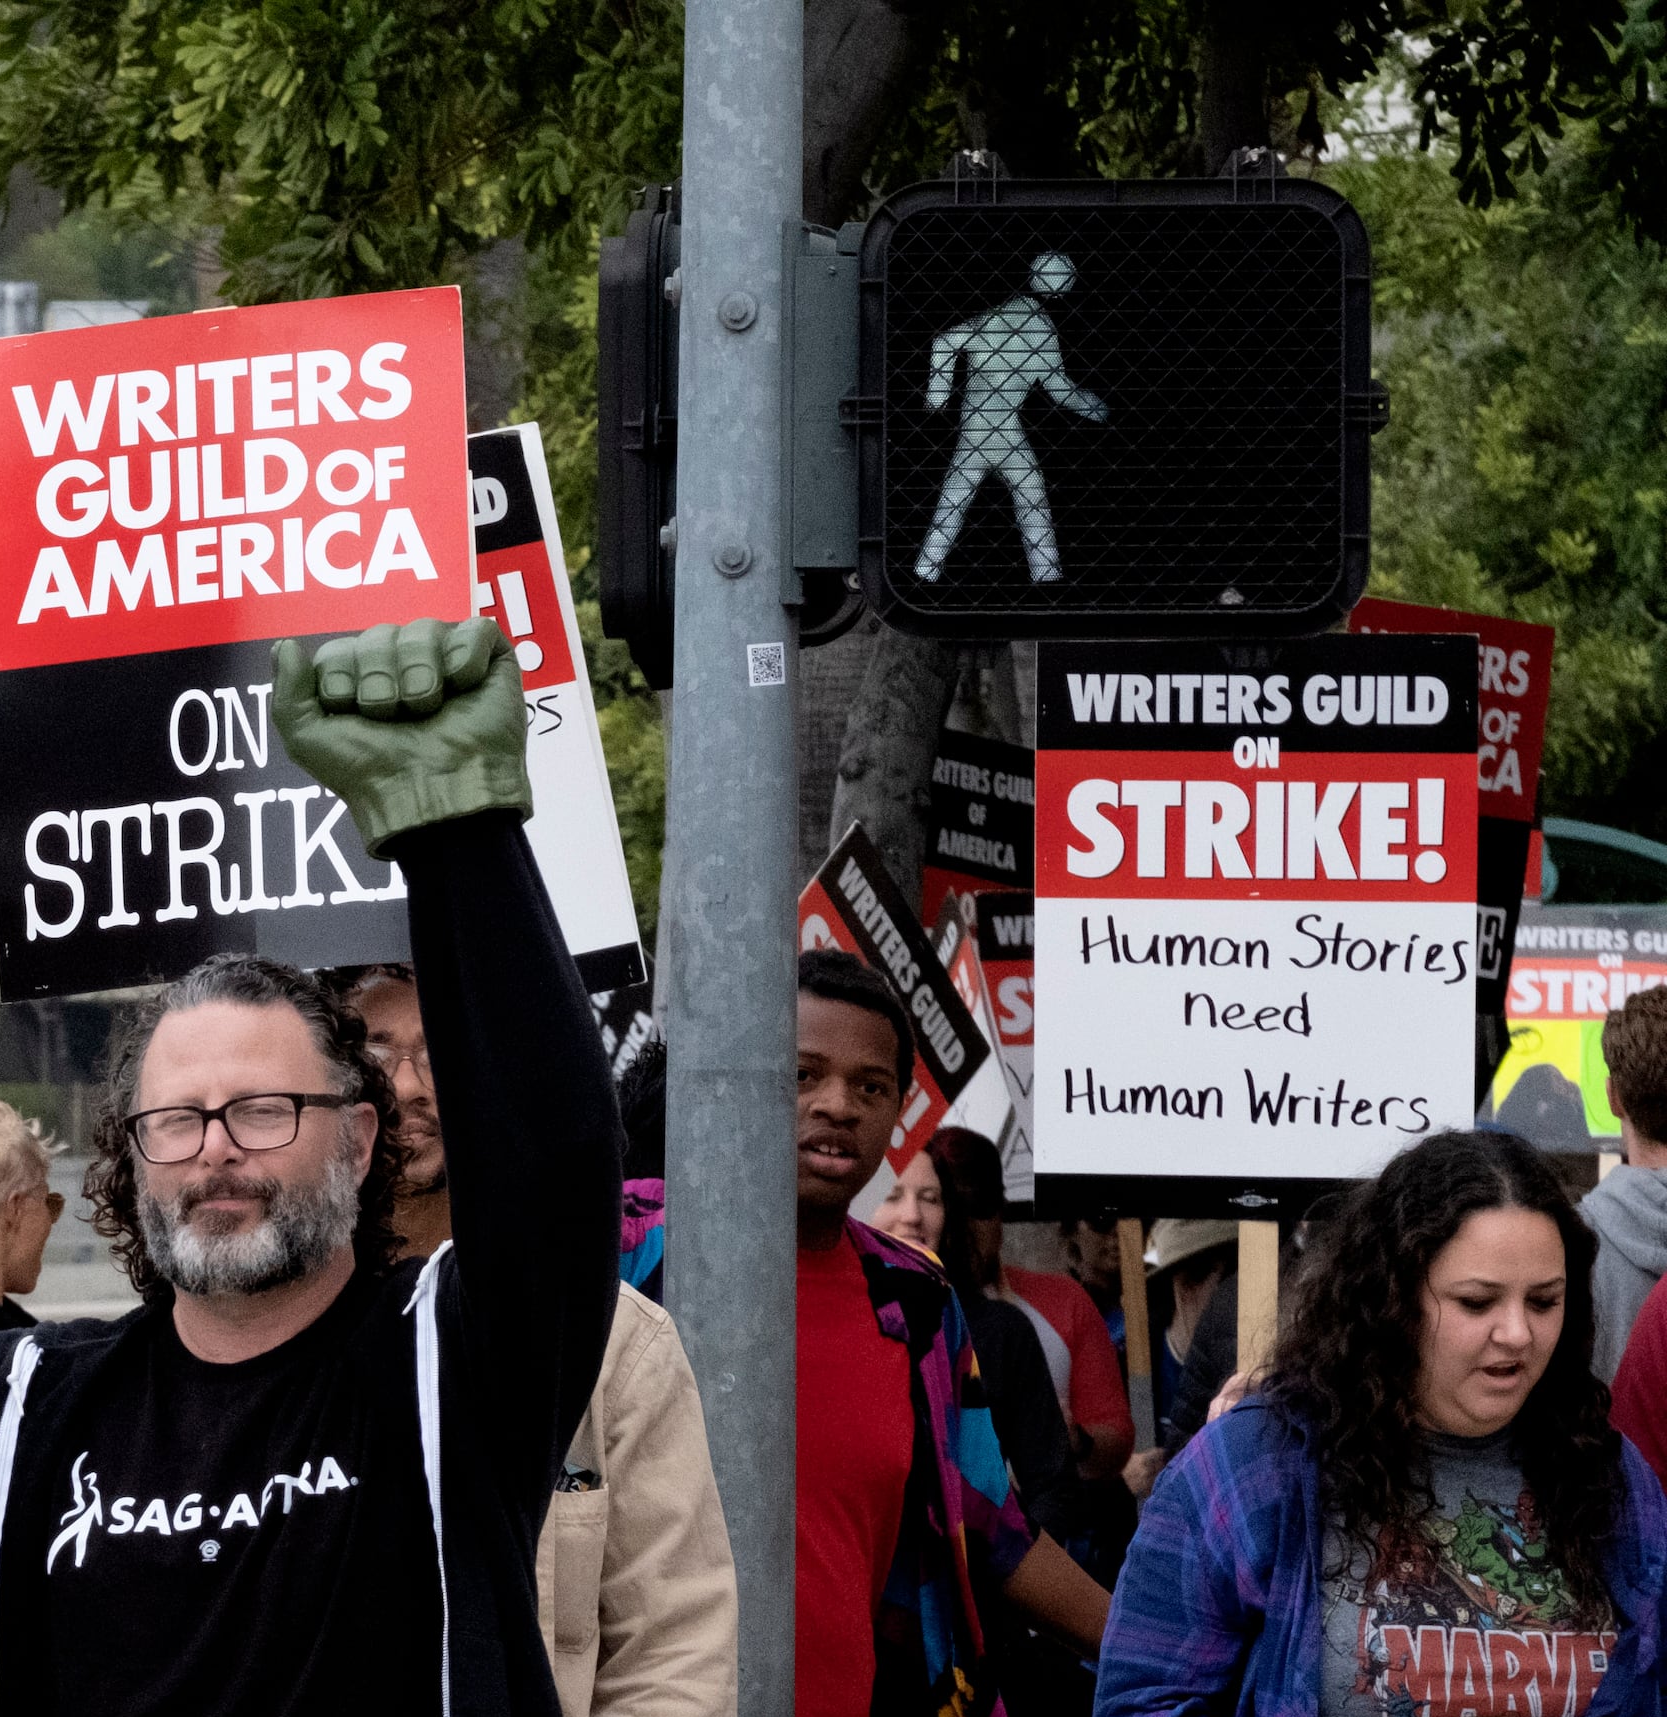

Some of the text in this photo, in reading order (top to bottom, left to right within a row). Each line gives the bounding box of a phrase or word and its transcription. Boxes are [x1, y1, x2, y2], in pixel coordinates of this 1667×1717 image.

[12, 342, 412, 457] WRITERS
[35, 437, 309, 538] GUILD
[315, 445, 406, 507] OF
[17, 507, 439, 625] AMERICA
[1067, 674, 1449, 725] WRITERS GUILD
[1484, 710, 1521, 744] OF
[170, 683, 273, 776] ON
[1233, 737, 1279, 769] ON
[933, 757, 991, 795] RITERS
[969, 803, 987, 825] OF
[1066, 778, 1448, 884] STRIKE!
[24, 783, 407, 942] STRIK
[937, 838, 1016, 872] AMERICA
[838, 857, 921, 993] WRITERS
[911, 984, 966, 1074] GUILD
[1081, 916, 1270, 970] Human
[1294, 915, 1469, 985] Stories
[1515, 926, 1628, 950] WRITERS
[1598, 954, 1623, 968] ON
[1185, 993, 1313, 1037] need
[1066, 1068, 1431, 1135] Human Writers
